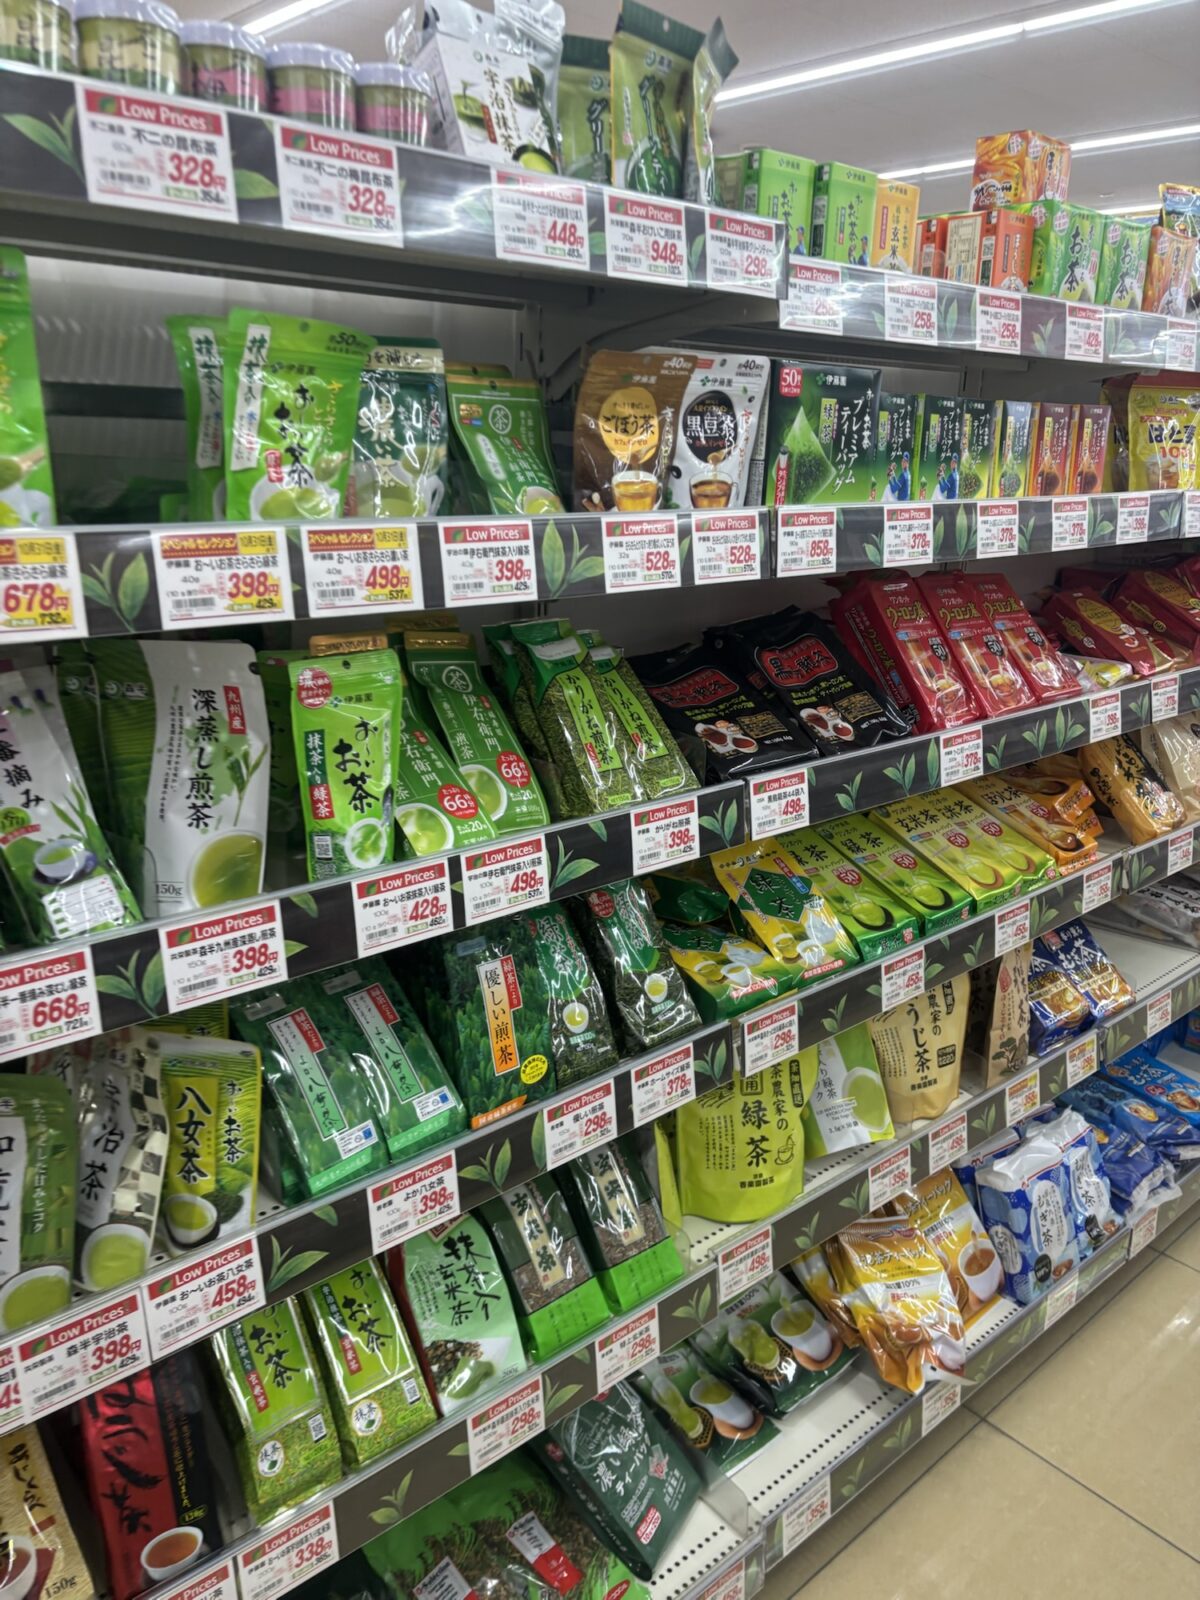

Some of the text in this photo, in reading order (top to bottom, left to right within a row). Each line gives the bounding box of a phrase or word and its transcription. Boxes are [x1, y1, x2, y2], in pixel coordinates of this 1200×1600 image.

[120, 98, 207, 131] Low Prices
[310, 135, 380, 165] Low Prices
[168, 152, 226, 190] 328円
[348, 184, 395, 219] 328円
[627, 204, 673, 222] Low Prices
[547, 219, 585, 248] 448円
[726, 221, 766, 238] Low Prices
[651, 240, 683, 266] 948円
[825, 374, 848, 387] 伊藤園
[601, 413, 655, 436] ごぼう茶
[686, 414, 738, 439] 黒豆茶
[832, 406, 852, 495] ティーバッグ
[844, 398, 866, 485] プレミアム
[710, 518, 749, 531] Low Prices
[794, 513, 829, 525] Low Prices
[898, 509, 926, 521] Low Prices
[466, 527, 519, 541] Low Prices
[623, 522, 667, 535] Low Prices
[911, 533, 931, 549] 378円
[645, 550, 676, 572] 528円
[730, 545, 757, 565] 528円
[809, 539, 833, 558] 858円
[365, 564, 409, 590] 498円
[494, 559, 531, 582] 398円
[4, 583, 69, 613] 678円
[228, 571, 279, 599] 398円
[227, 691, 245, 730] 九州産
[343, 692, 374, 704] 伊藤園
[462, 693, 502, 752] 伊右衛門
[185, 687, 220, 830] 深蒸し煎茶
[501, 763, 520, 778] 66
[765, 775, 800, 792] Low Prices
[443, 797, 463, 812] 66
[650, 803, 688, 821] Low Prices
[782, 798, 806, 816] 498円
[894, 808, 941, 834] 玄米茶
[668, 828, 696, 848] 398円
[841, 832, 884, 855] 緑茶
[485, 844, 534, 866] Low Prices
[154, 884, 183, 897] 150g
[379, 868, 436, 892] Low Prices
[510, 870, 544, 894] 498円
[408, 896, 447, 923] 428円
[194, 913, 263, 940] Low Prices
[231, 943, 278, 974] 398円
[25, 960, 71, 984] Prices
[32, 993, 90, 1028] 668円
[484, 968, 514, 1066] 優しい煎茶
[774, 1033, 797, 1050] 298円
[648, 1051, 688, 1075] Low Prices
[667, 1074, 692, 1096] 378円
[770, 1063, 789, 1131] 茶農家の
[563, 1091, 605, 1115] Low Prices
[176, 1086, 212, 1185] 八女茶
[584, 1112, 613, 1135] 298円
[740, 1100, 771, 1169] 緑茶
[81, 1079, 124, 1201] 宇治茶
[391, 1162, 443, 1193] Low Prices
[419, 1186, 455, 1215] 398円
[175, 1248, 241, 1287] Low Prices
[211, 1274, 257, 1307] 458円
[438, 1262, 475, 1327] 玄米茶
[49, 1304, 124, 1347] Low Prices
[612, 1313, 650, 1343] Low Prices
[90, 1334, 142, 1371] 398円
[630, 1335, 656, 1359] 298円
[488, 1388, 533, 1419] Low Prices
[511, 1410, 541, 1437] 298円
[264, 1513, 321, 1554] Low Prices
[293, 1538, 333, 1568] 338円
